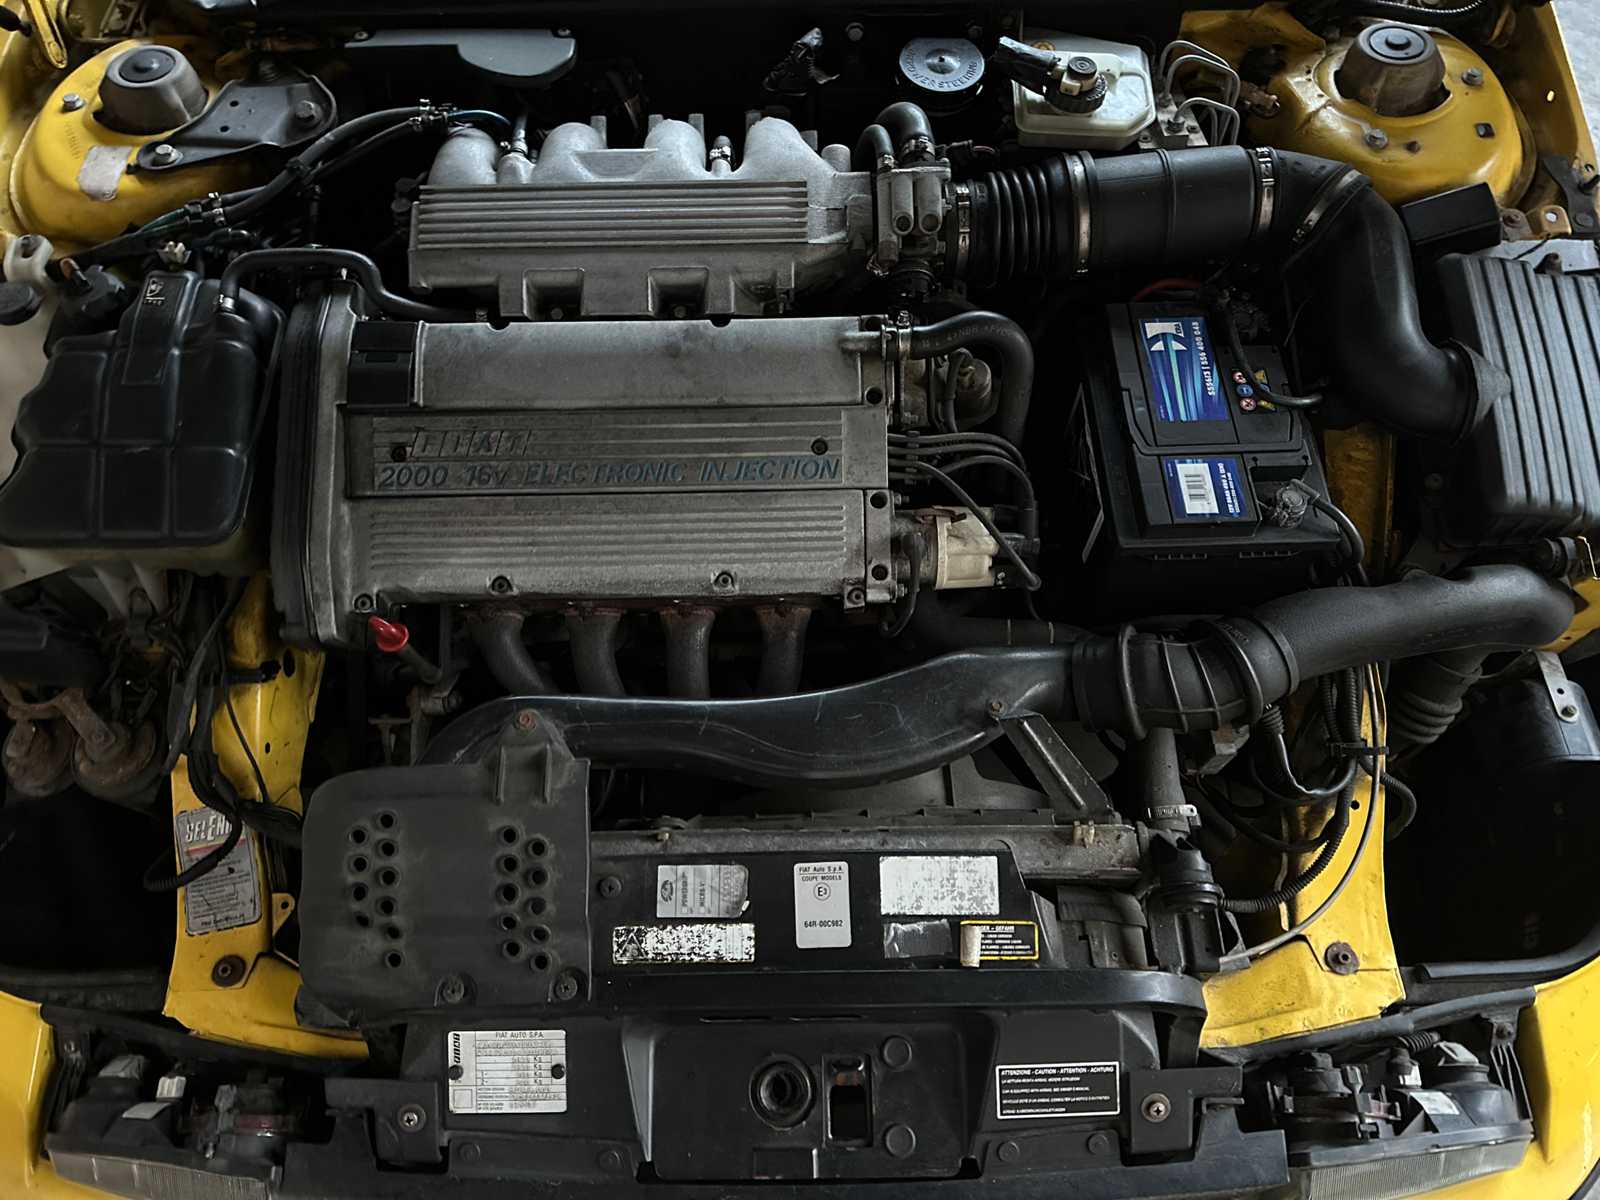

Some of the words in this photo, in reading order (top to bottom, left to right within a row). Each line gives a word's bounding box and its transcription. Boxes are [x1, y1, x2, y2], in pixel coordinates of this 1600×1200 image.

[412, 431, 531, 456] FIAT
[379, 464, 449, 487] 2000
[523, 462, 688, 485] ELECTRONIC
[700, 457, 839, 482] INJECTION
